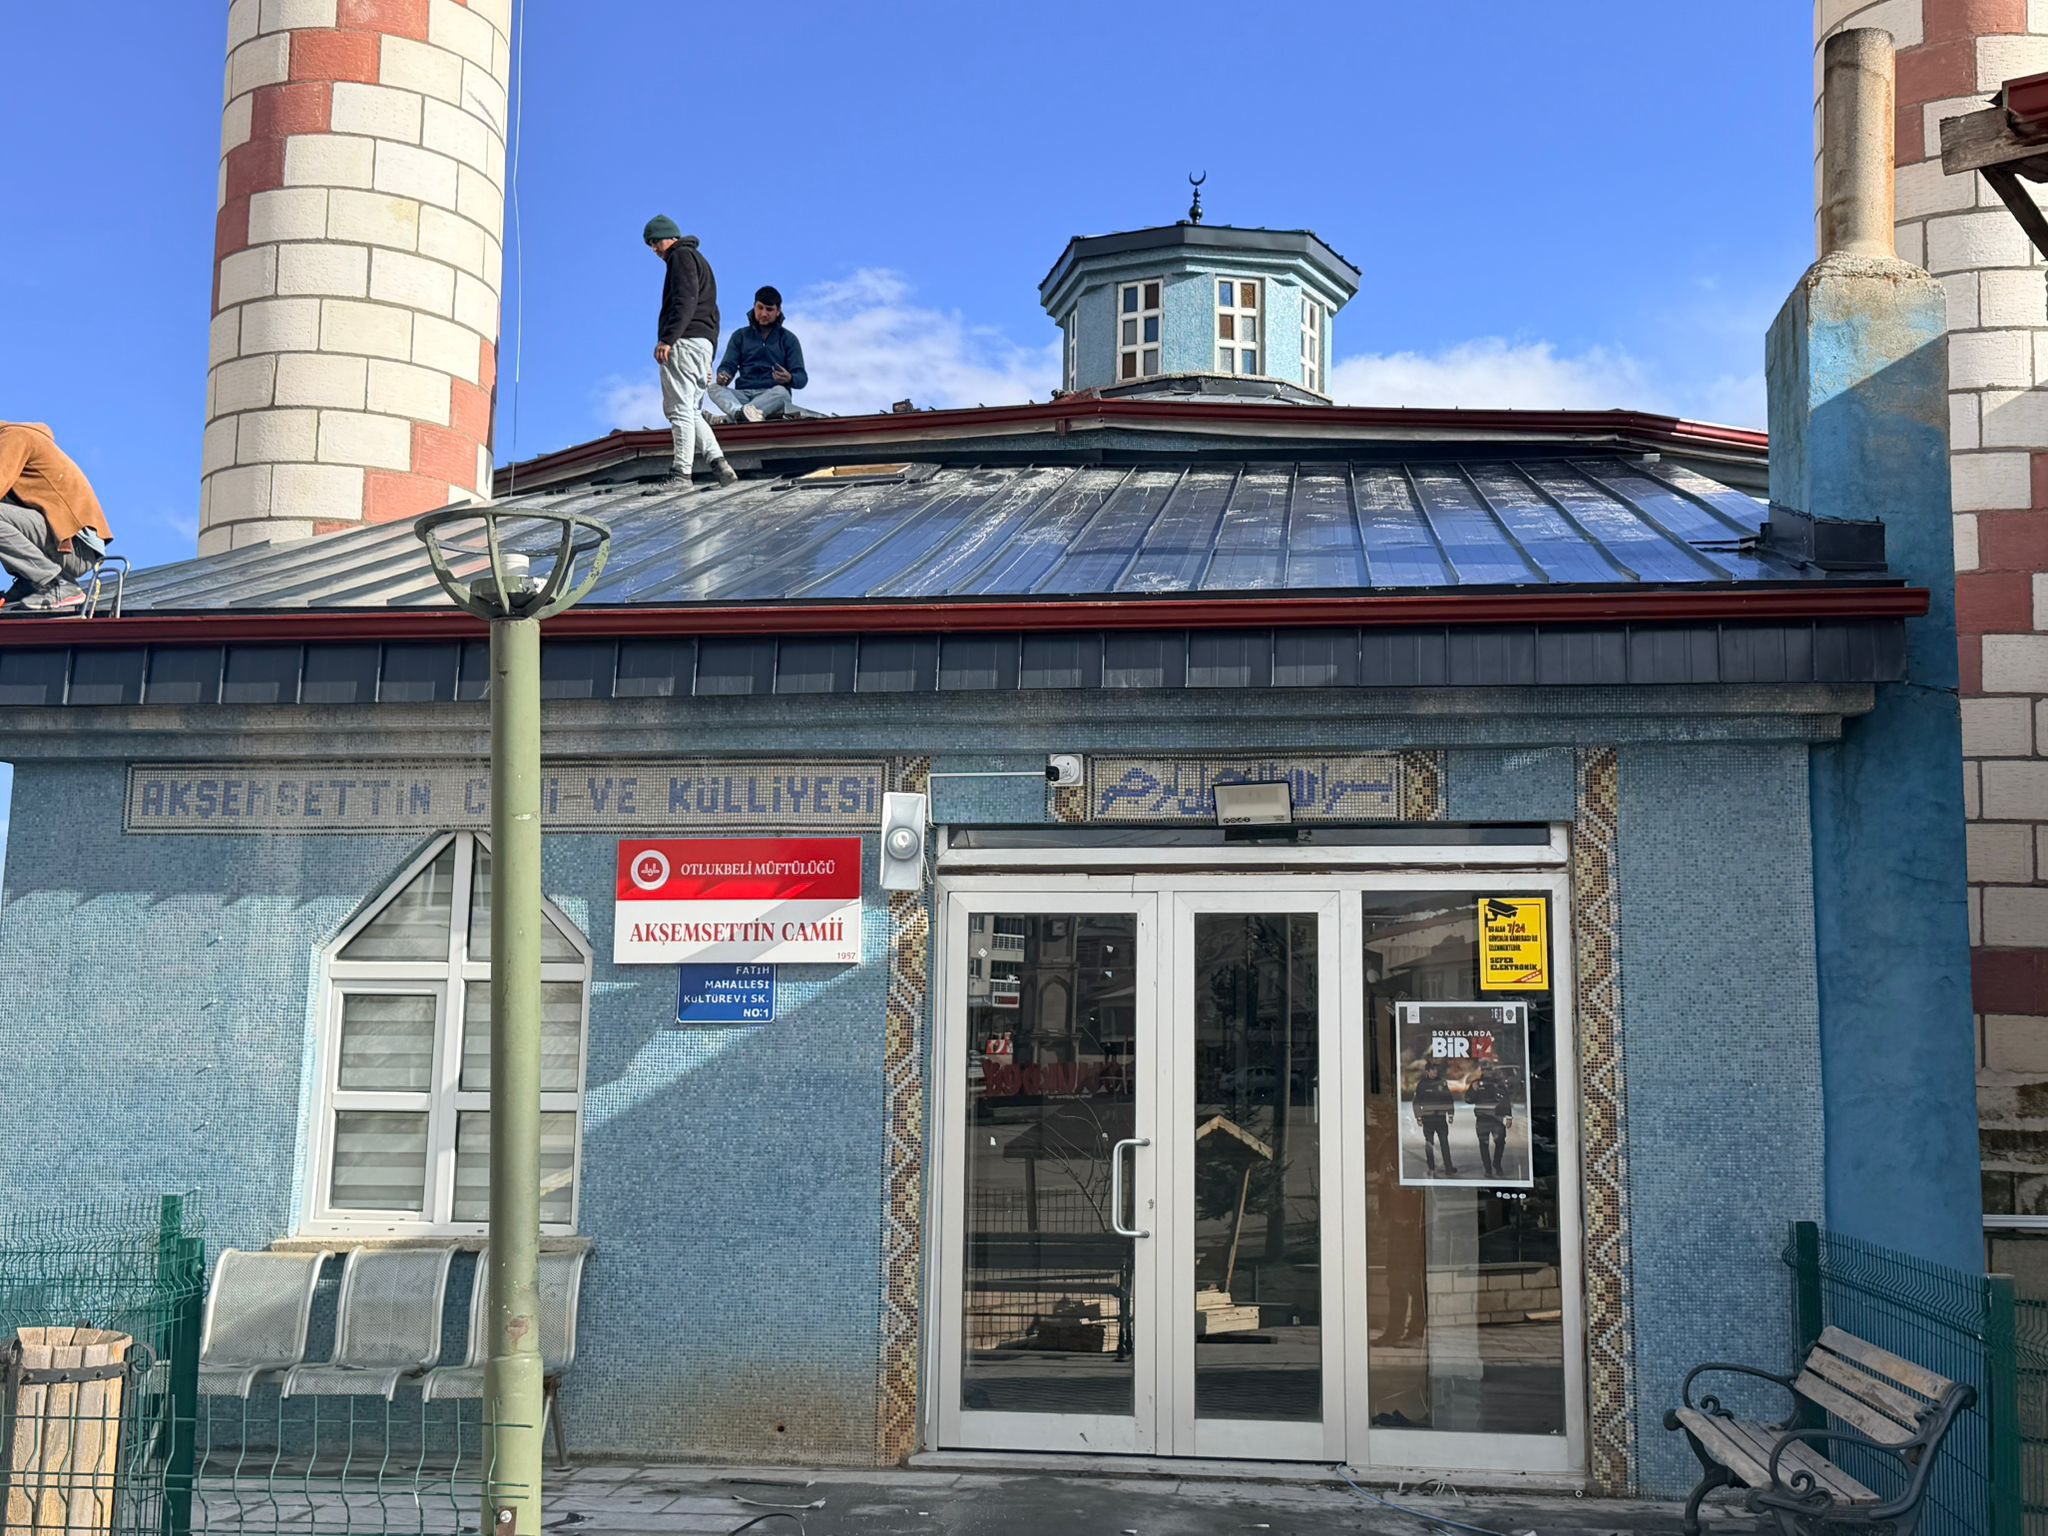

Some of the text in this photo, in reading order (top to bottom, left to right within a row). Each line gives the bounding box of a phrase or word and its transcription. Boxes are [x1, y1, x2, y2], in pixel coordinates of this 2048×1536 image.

[680, 861, 752, 876] OTLUKBELİ
[629, 917, 843, 945] AKŞEMSETTİN CAMİİ
[1507, 920, 1526, 935] 7/24
[750, 993, 770, 1004] SK.
[742, 1008, 769, 1018] NO:1
